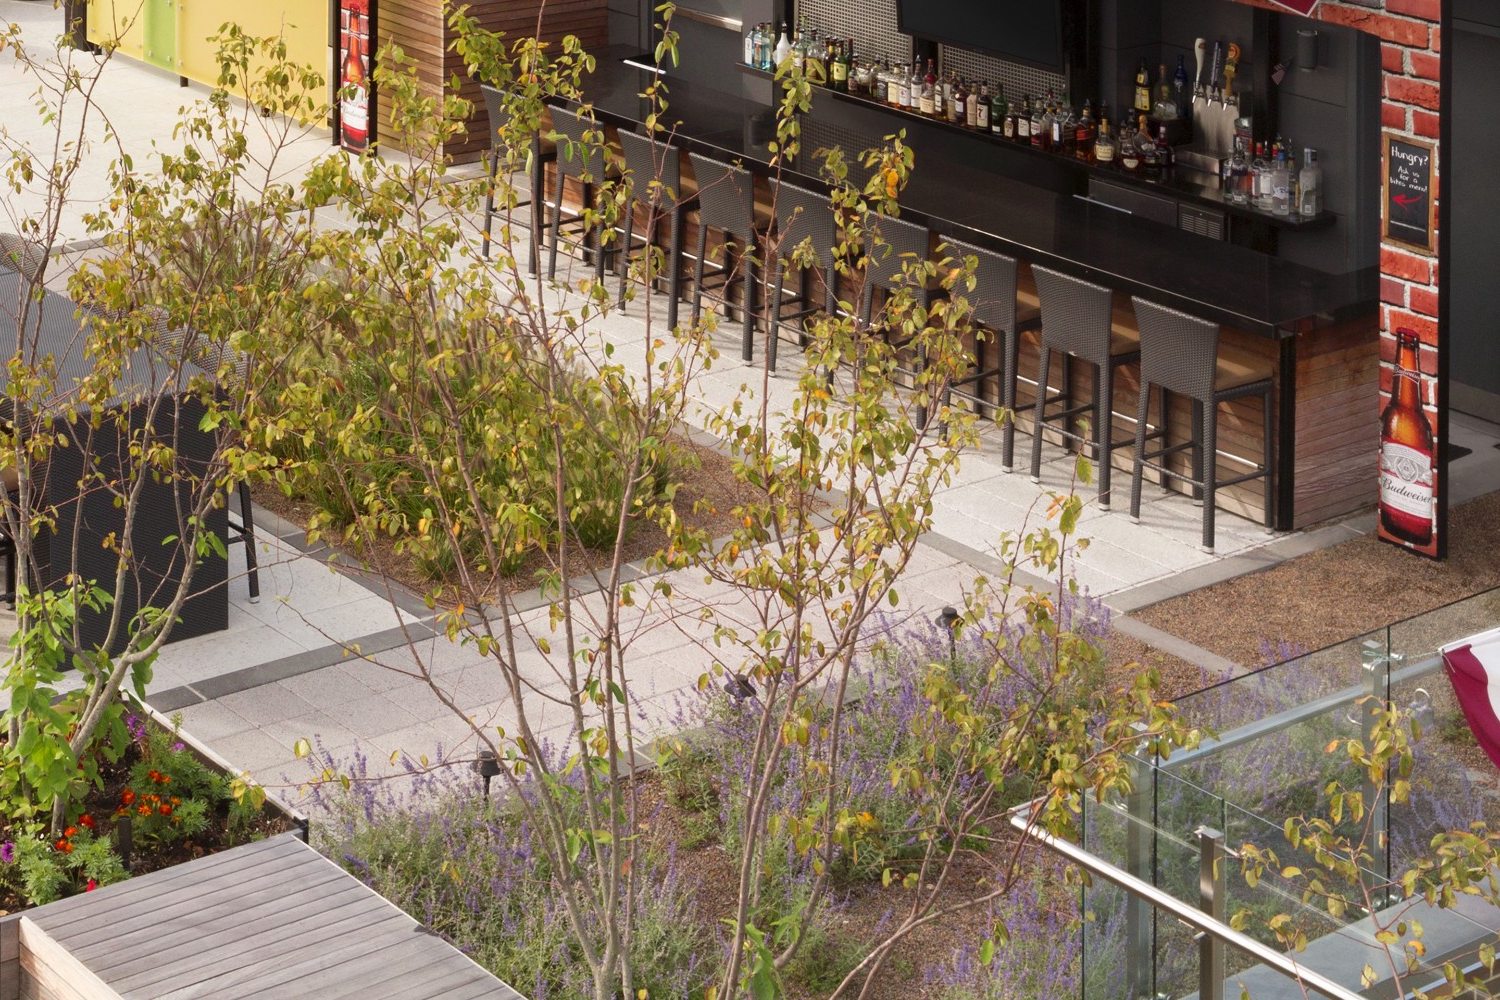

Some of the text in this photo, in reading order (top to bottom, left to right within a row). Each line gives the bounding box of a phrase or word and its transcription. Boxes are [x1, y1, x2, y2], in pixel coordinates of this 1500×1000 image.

[1391, 146, 1428, 166] Hungry?
[1398, 166, 1409, 175] Ask
[1383, 478, 1431, 503] Budweiser
